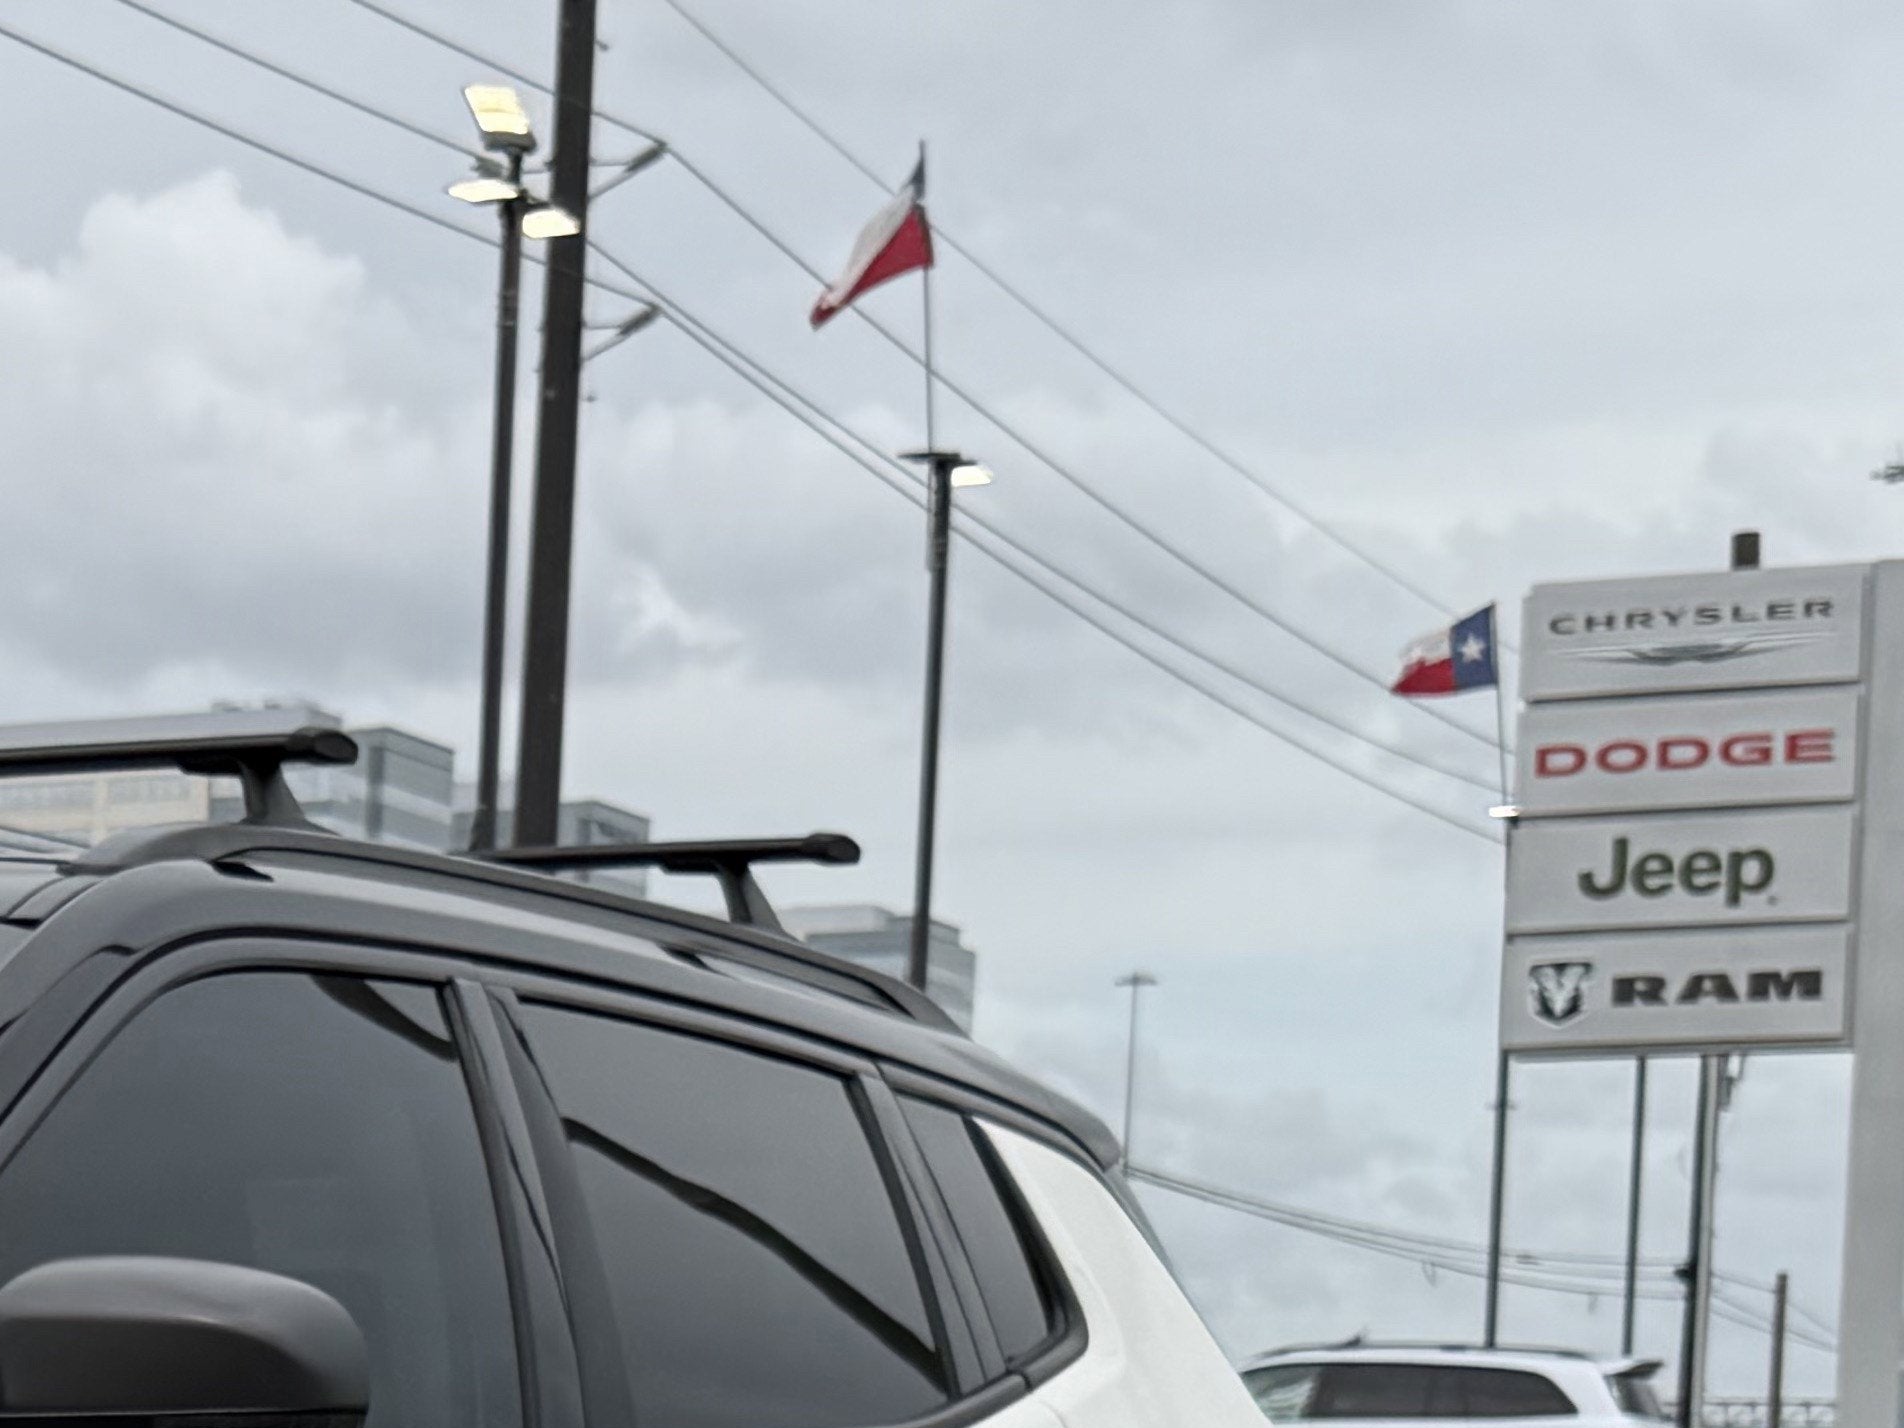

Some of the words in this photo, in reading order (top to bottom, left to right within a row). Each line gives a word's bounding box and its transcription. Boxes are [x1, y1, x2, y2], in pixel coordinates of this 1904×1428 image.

[1548, 599, 1835, 636] CHRYSLER
[1533, 730, 1835, 778] DODGE
[1577, 837, 1776, 907] Jeep
[1610, 970, 1823, 1008] RAM
